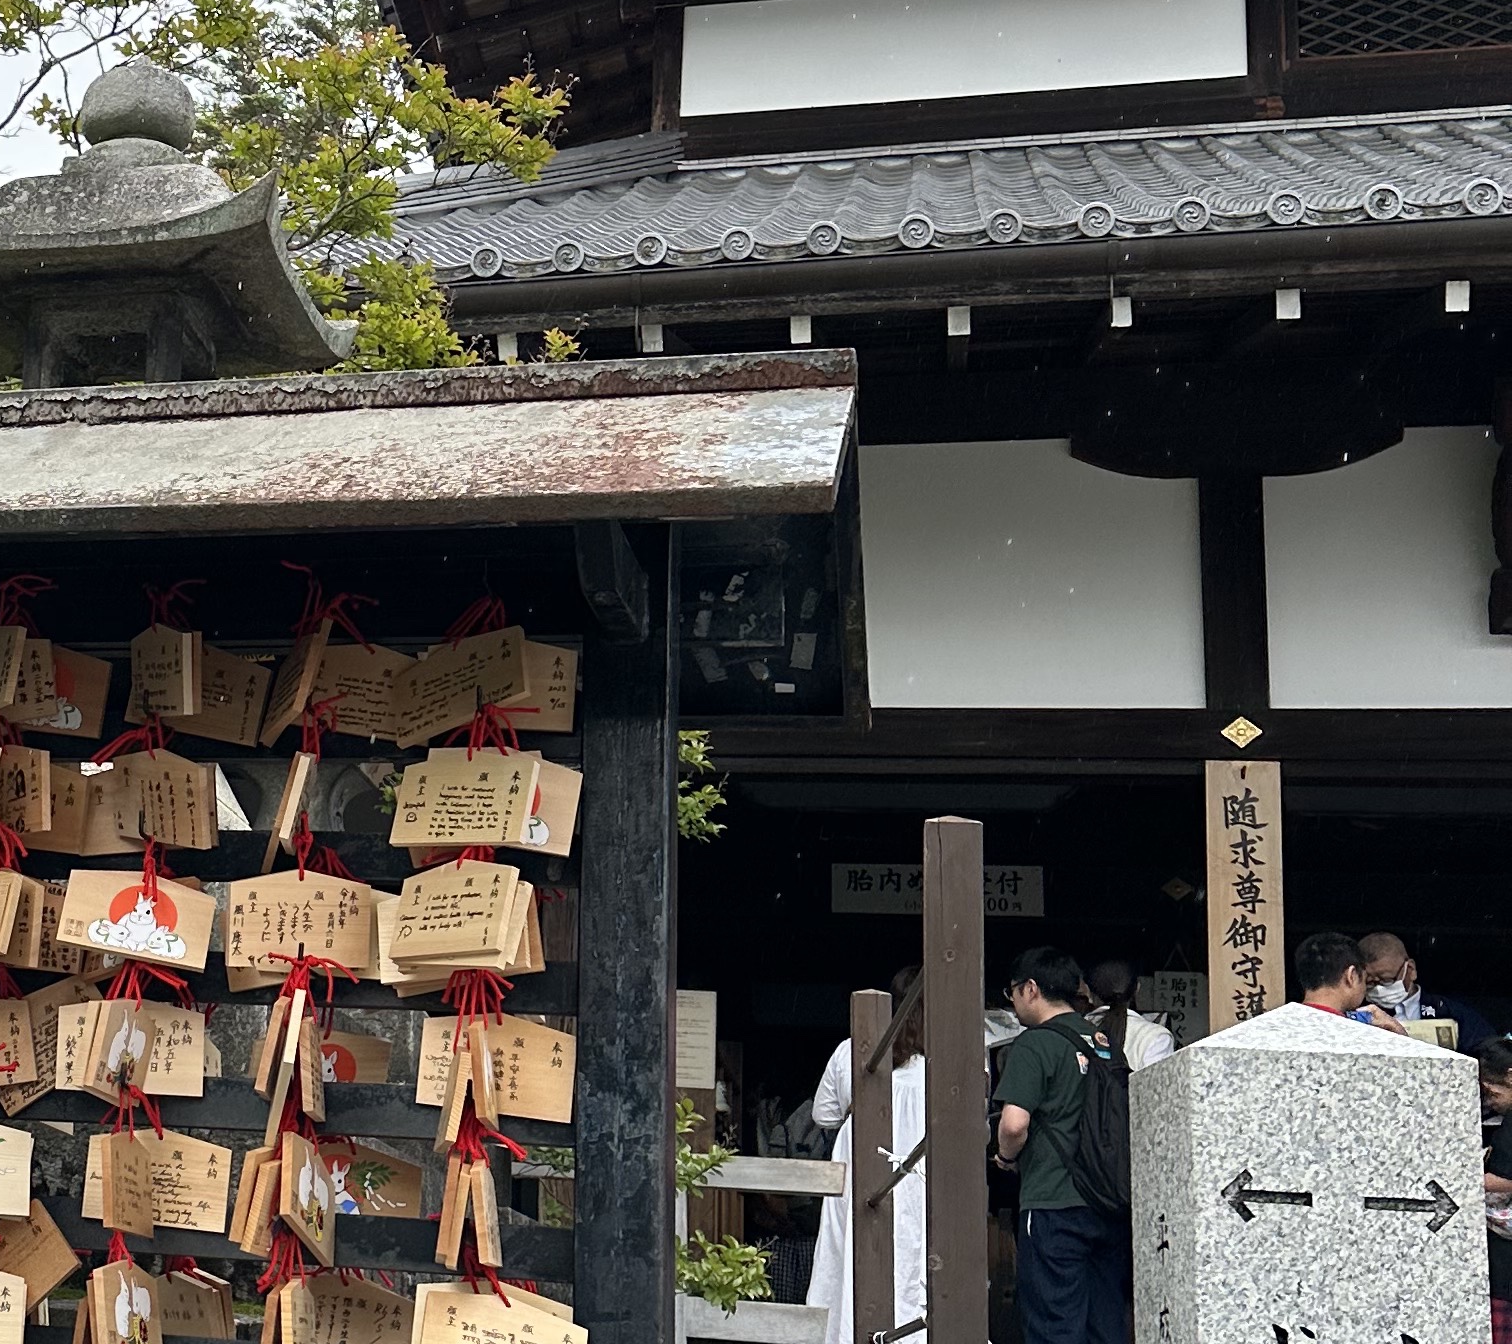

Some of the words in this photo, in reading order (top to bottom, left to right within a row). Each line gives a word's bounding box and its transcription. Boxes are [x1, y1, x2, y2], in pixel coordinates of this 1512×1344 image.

[509, 770, 521, 795] 奉納
[1222, 787, 1269, 1023] 随求尊御守護
[261, 908, 271, 942] ように
[181, 1020, 193, 1045] 奉納
[150, 1027, 165, 1072] 五月九日
[164, 1020, 181, 1074] 令和五年
[551, 1041, 563, 1068] 奉納
[206, 1153, 218, 1179] 奉納
[0, 1287, 11, 1312] 奉納
